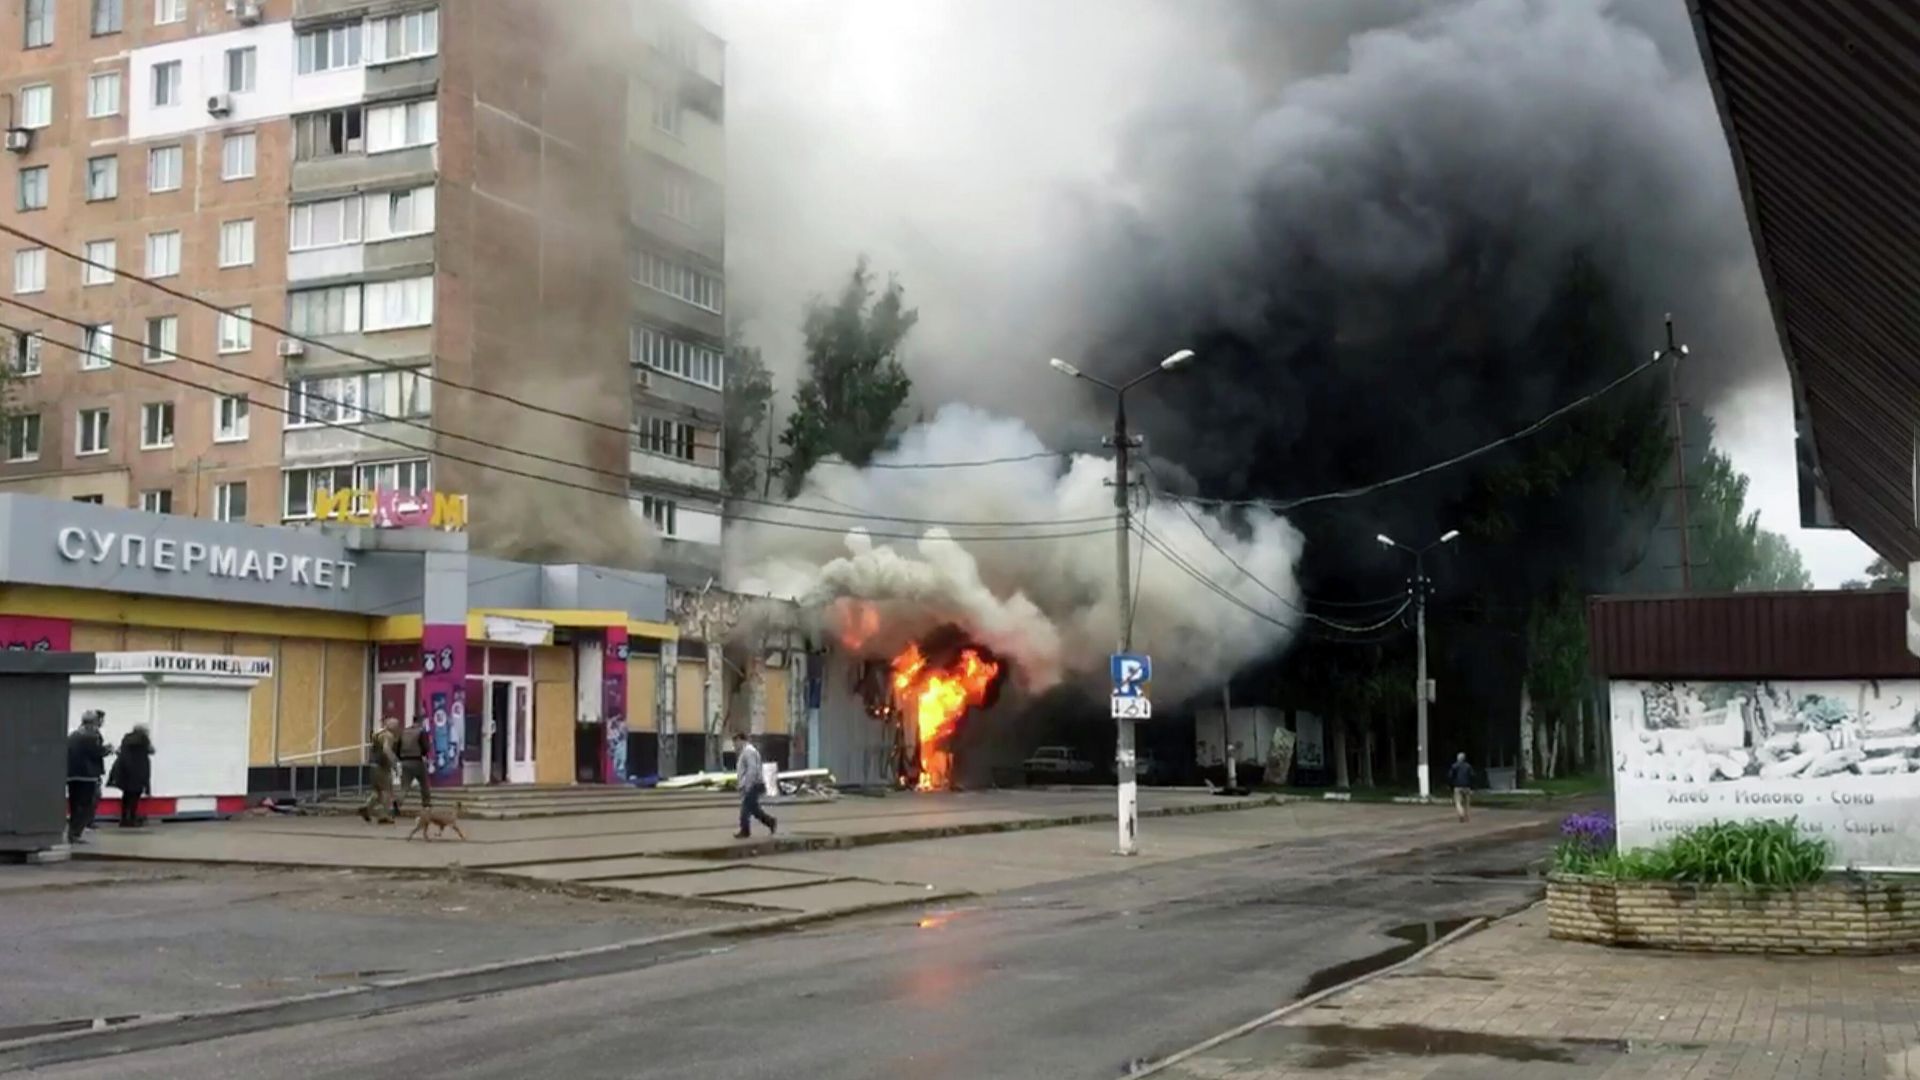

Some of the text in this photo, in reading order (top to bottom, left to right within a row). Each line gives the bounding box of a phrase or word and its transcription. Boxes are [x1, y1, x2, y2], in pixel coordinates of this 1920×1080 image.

[57, 526, 356, 589] СУПЕРМАРКЕТ
[154, 655, 206, 671] ИТОГИ
[211, 655, 271, 674] НЕДЛИ
[1667, 789, 1875, 806] Хлеб Молоко Соки
